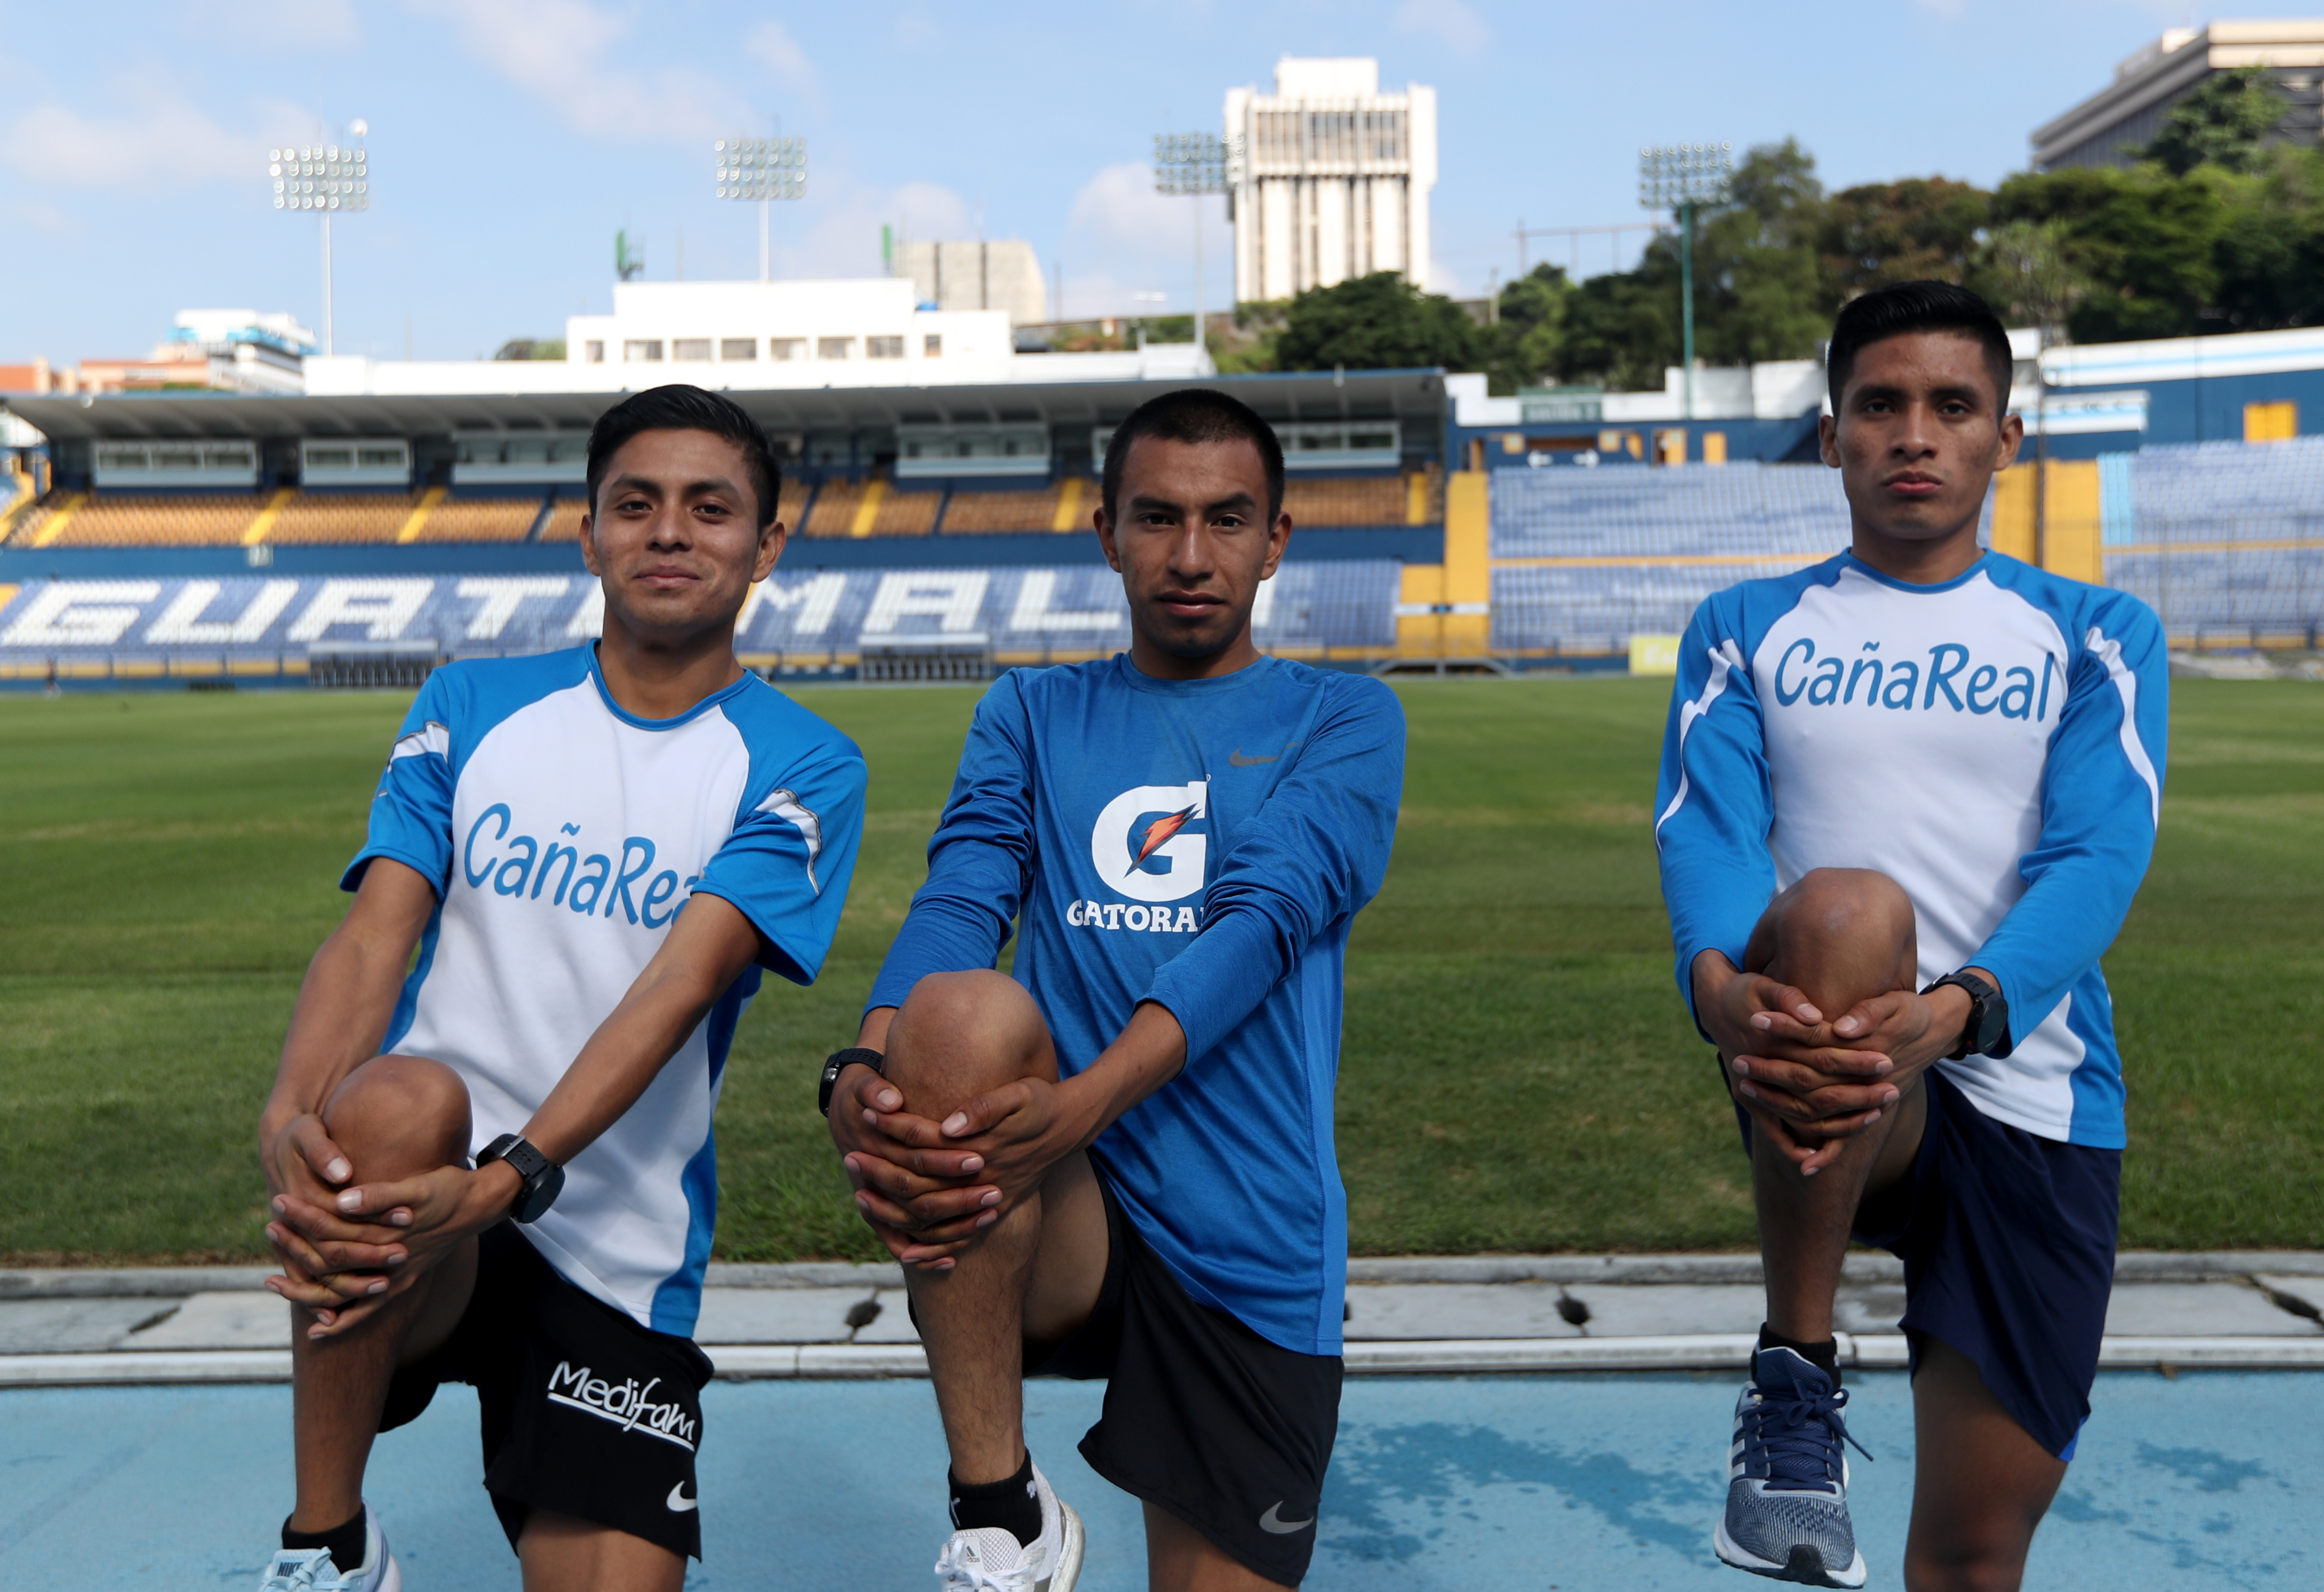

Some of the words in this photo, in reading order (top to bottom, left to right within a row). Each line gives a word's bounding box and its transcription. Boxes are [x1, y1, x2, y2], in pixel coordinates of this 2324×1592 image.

[1, 570, 1276, 646] GUATMAL
[1775, 638, 2054, 722] CañaReal
[464, 803, 699, 928] CañaRe
[1092, 781, 1207, 902] G
[1066, 899, 1205, 932] GATORA
[548, 1360, 695, 1441] Medifam
